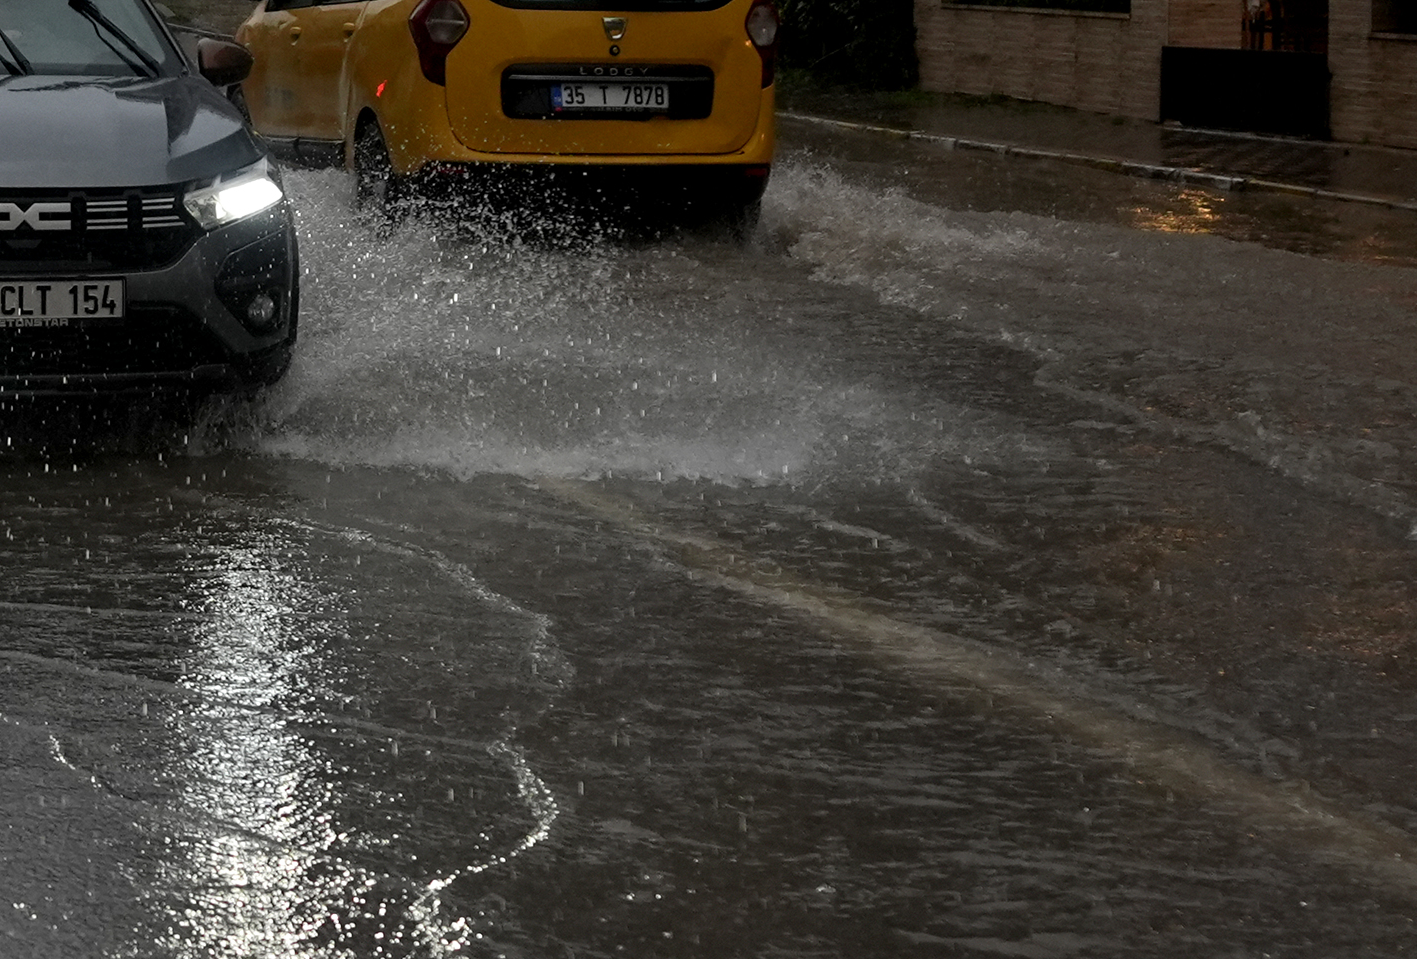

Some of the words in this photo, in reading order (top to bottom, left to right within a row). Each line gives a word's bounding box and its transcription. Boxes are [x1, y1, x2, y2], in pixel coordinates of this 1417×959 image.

[579, 66, 649, 76] LODGY
[564, 86, 585, 104] 35
[600, 86, 608, 104] T
[622, 86, 664, 105] 7878
[0, 285, 52, 315] CLT
[69, 285, 116, 315] 154
